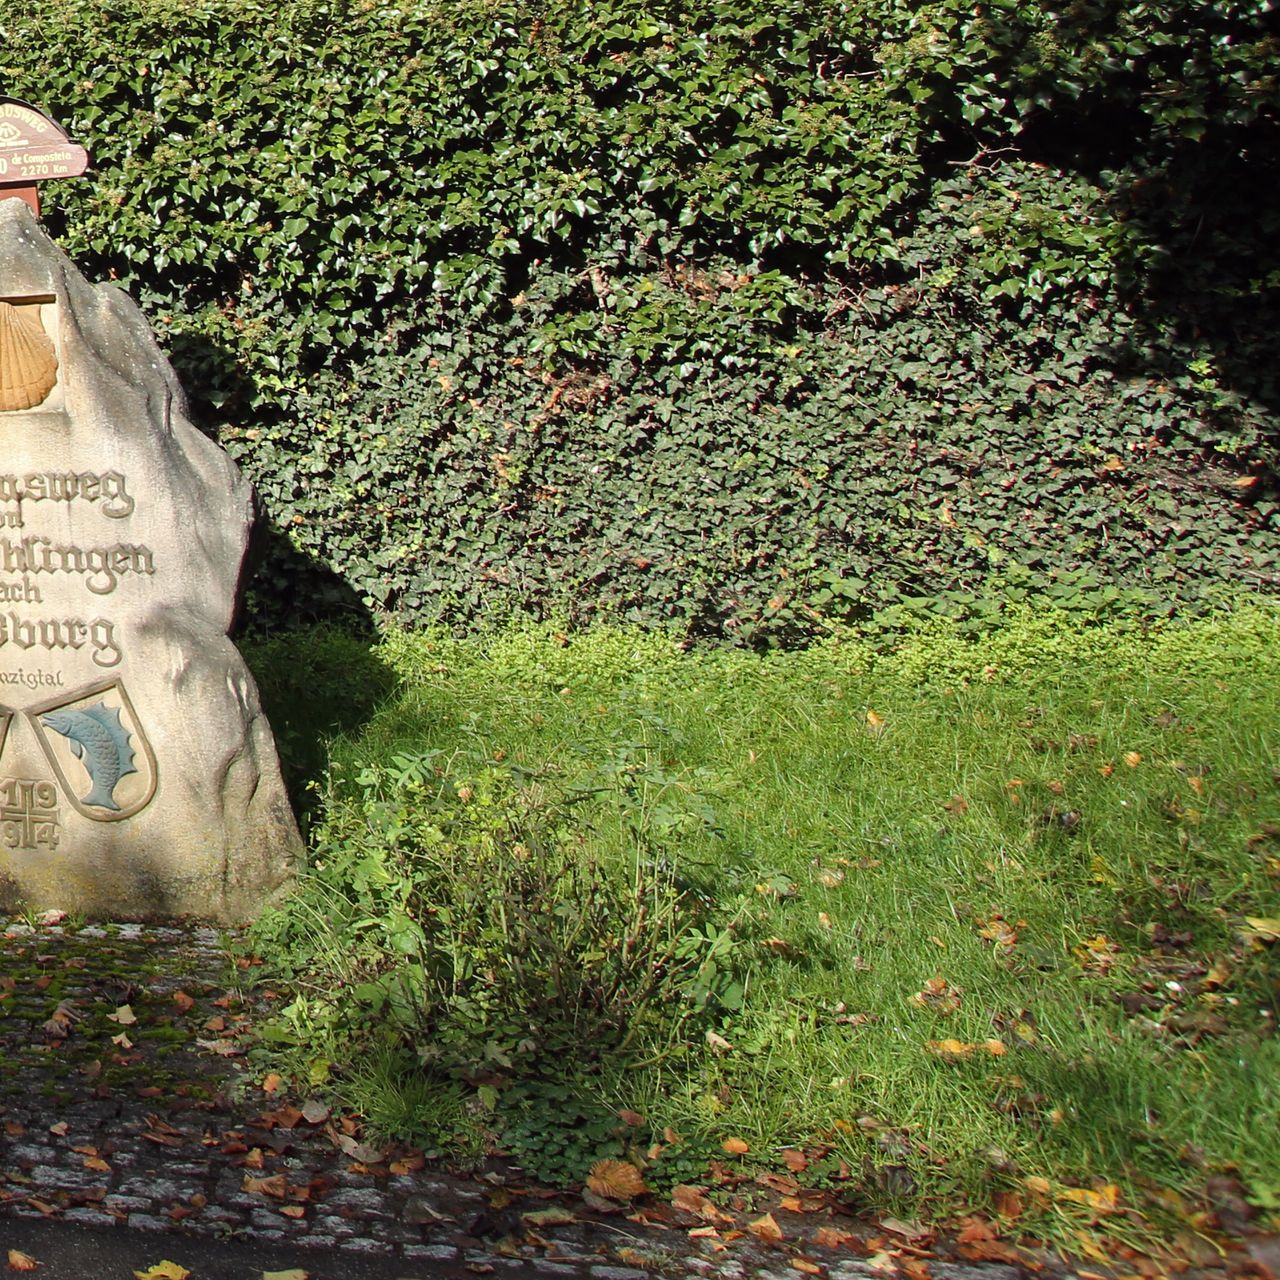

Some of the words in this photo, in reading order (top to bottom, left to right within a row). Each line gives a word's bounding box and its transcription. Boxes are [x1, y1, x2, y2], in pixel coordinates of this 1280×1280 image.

[11, 153, 22, 165] de
[23, 151, 72, 164] Compostela
[21, 165, 48, 176] 2270
[53, 164, 68, 173] Km
